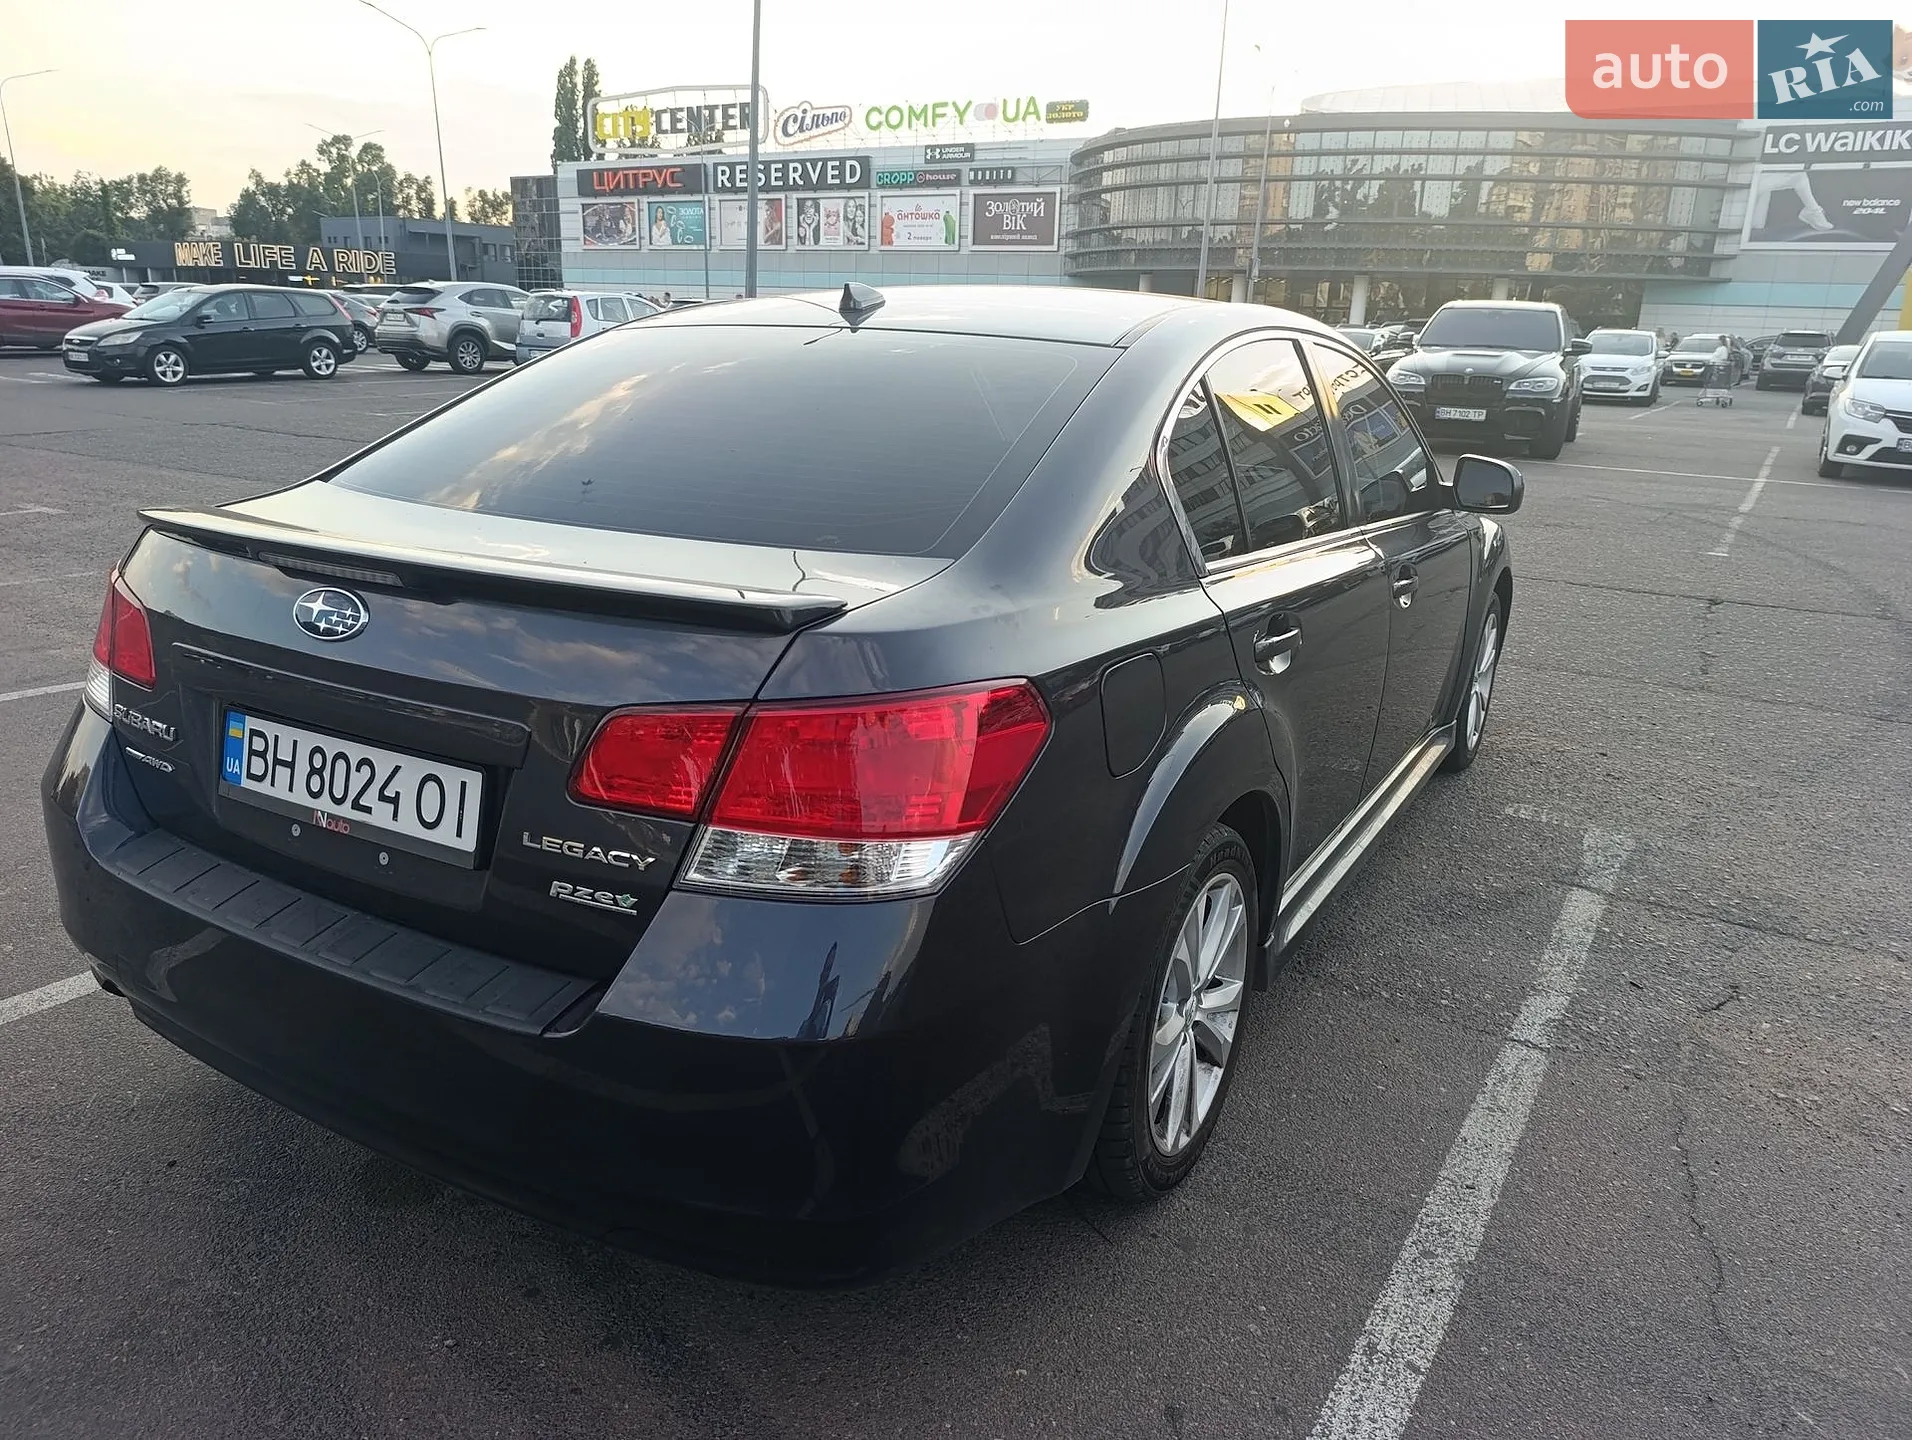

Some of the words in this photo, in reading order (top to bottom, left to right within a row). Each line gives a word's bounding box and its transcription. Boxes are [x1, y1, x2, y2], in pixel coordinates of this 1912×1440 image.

[596, 108, 651, 140] CITY
[781, 108, 847, 138] Сільпо
[865, 100, 973, 131] COMFY
[1002, 96, 1042, 123] UA
[1763, 132, 1801, 154] LC
[592, 167, 684, 193] ЦИТРУС
[717, 159, 862, 188] RESERVED
[877, 171, 915, 185] CROPP
[1863, 198, 1901, 206] balance
[175, 242, 223, 267] MAKE
[234, 243, 296, 270] LIFE
[306, 247, 328, 272] A
[333, 249, 397, 275] RIDE
[113, 703, 176, 741] SUBARU
[226, 756, 241, 776] UA
[246, 727, 298, 793] BH
[305, 745, 403, 822] 8024
[522, 831, 657, 872] LEGACY
